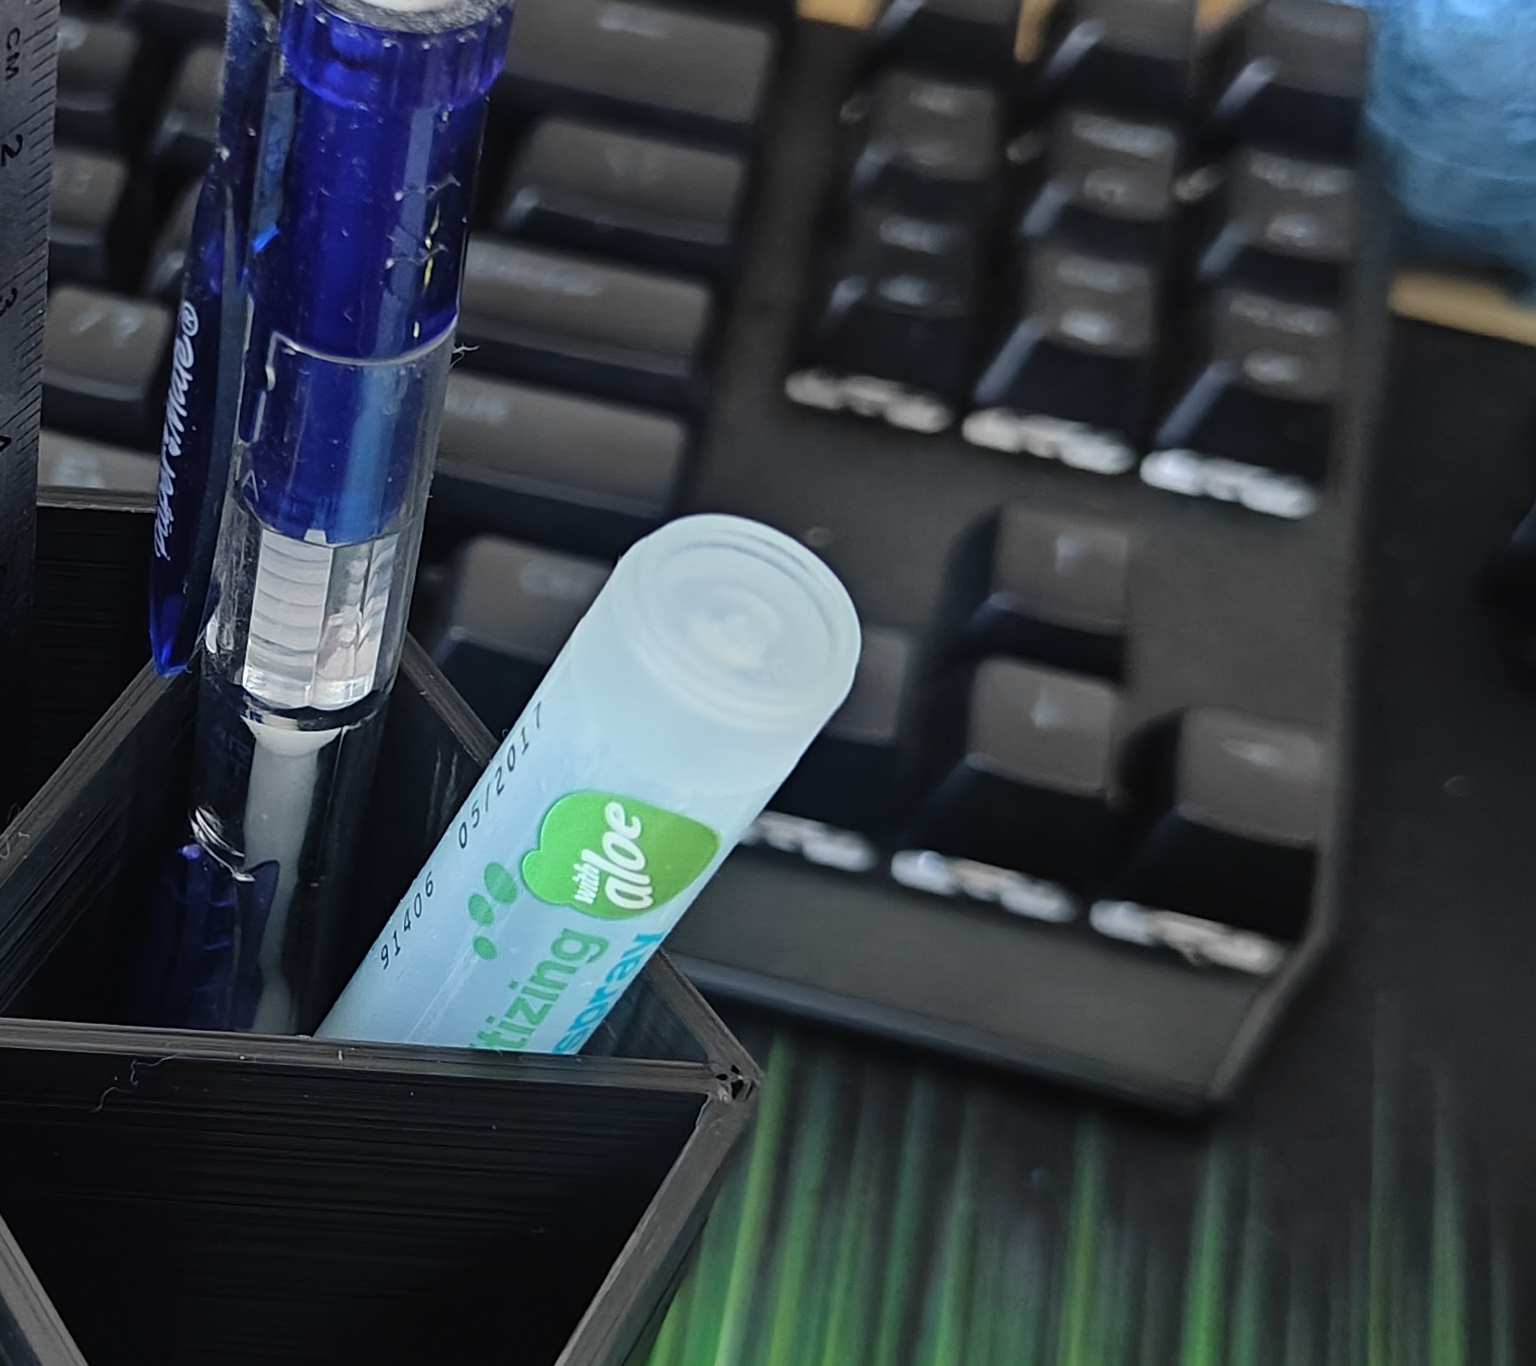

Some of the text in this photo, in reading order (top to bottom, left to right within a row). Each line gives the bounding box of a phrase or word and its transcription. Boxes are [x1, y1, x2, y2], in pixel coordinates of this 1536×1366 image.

[0, 134, 23, 167] 2
[378, 701, 545, 971] 91406 05/2017
[574, 848, 601, 904] with
[601, 801, 654, 910] aloe
[473, 928, 611, 1052] tizing
